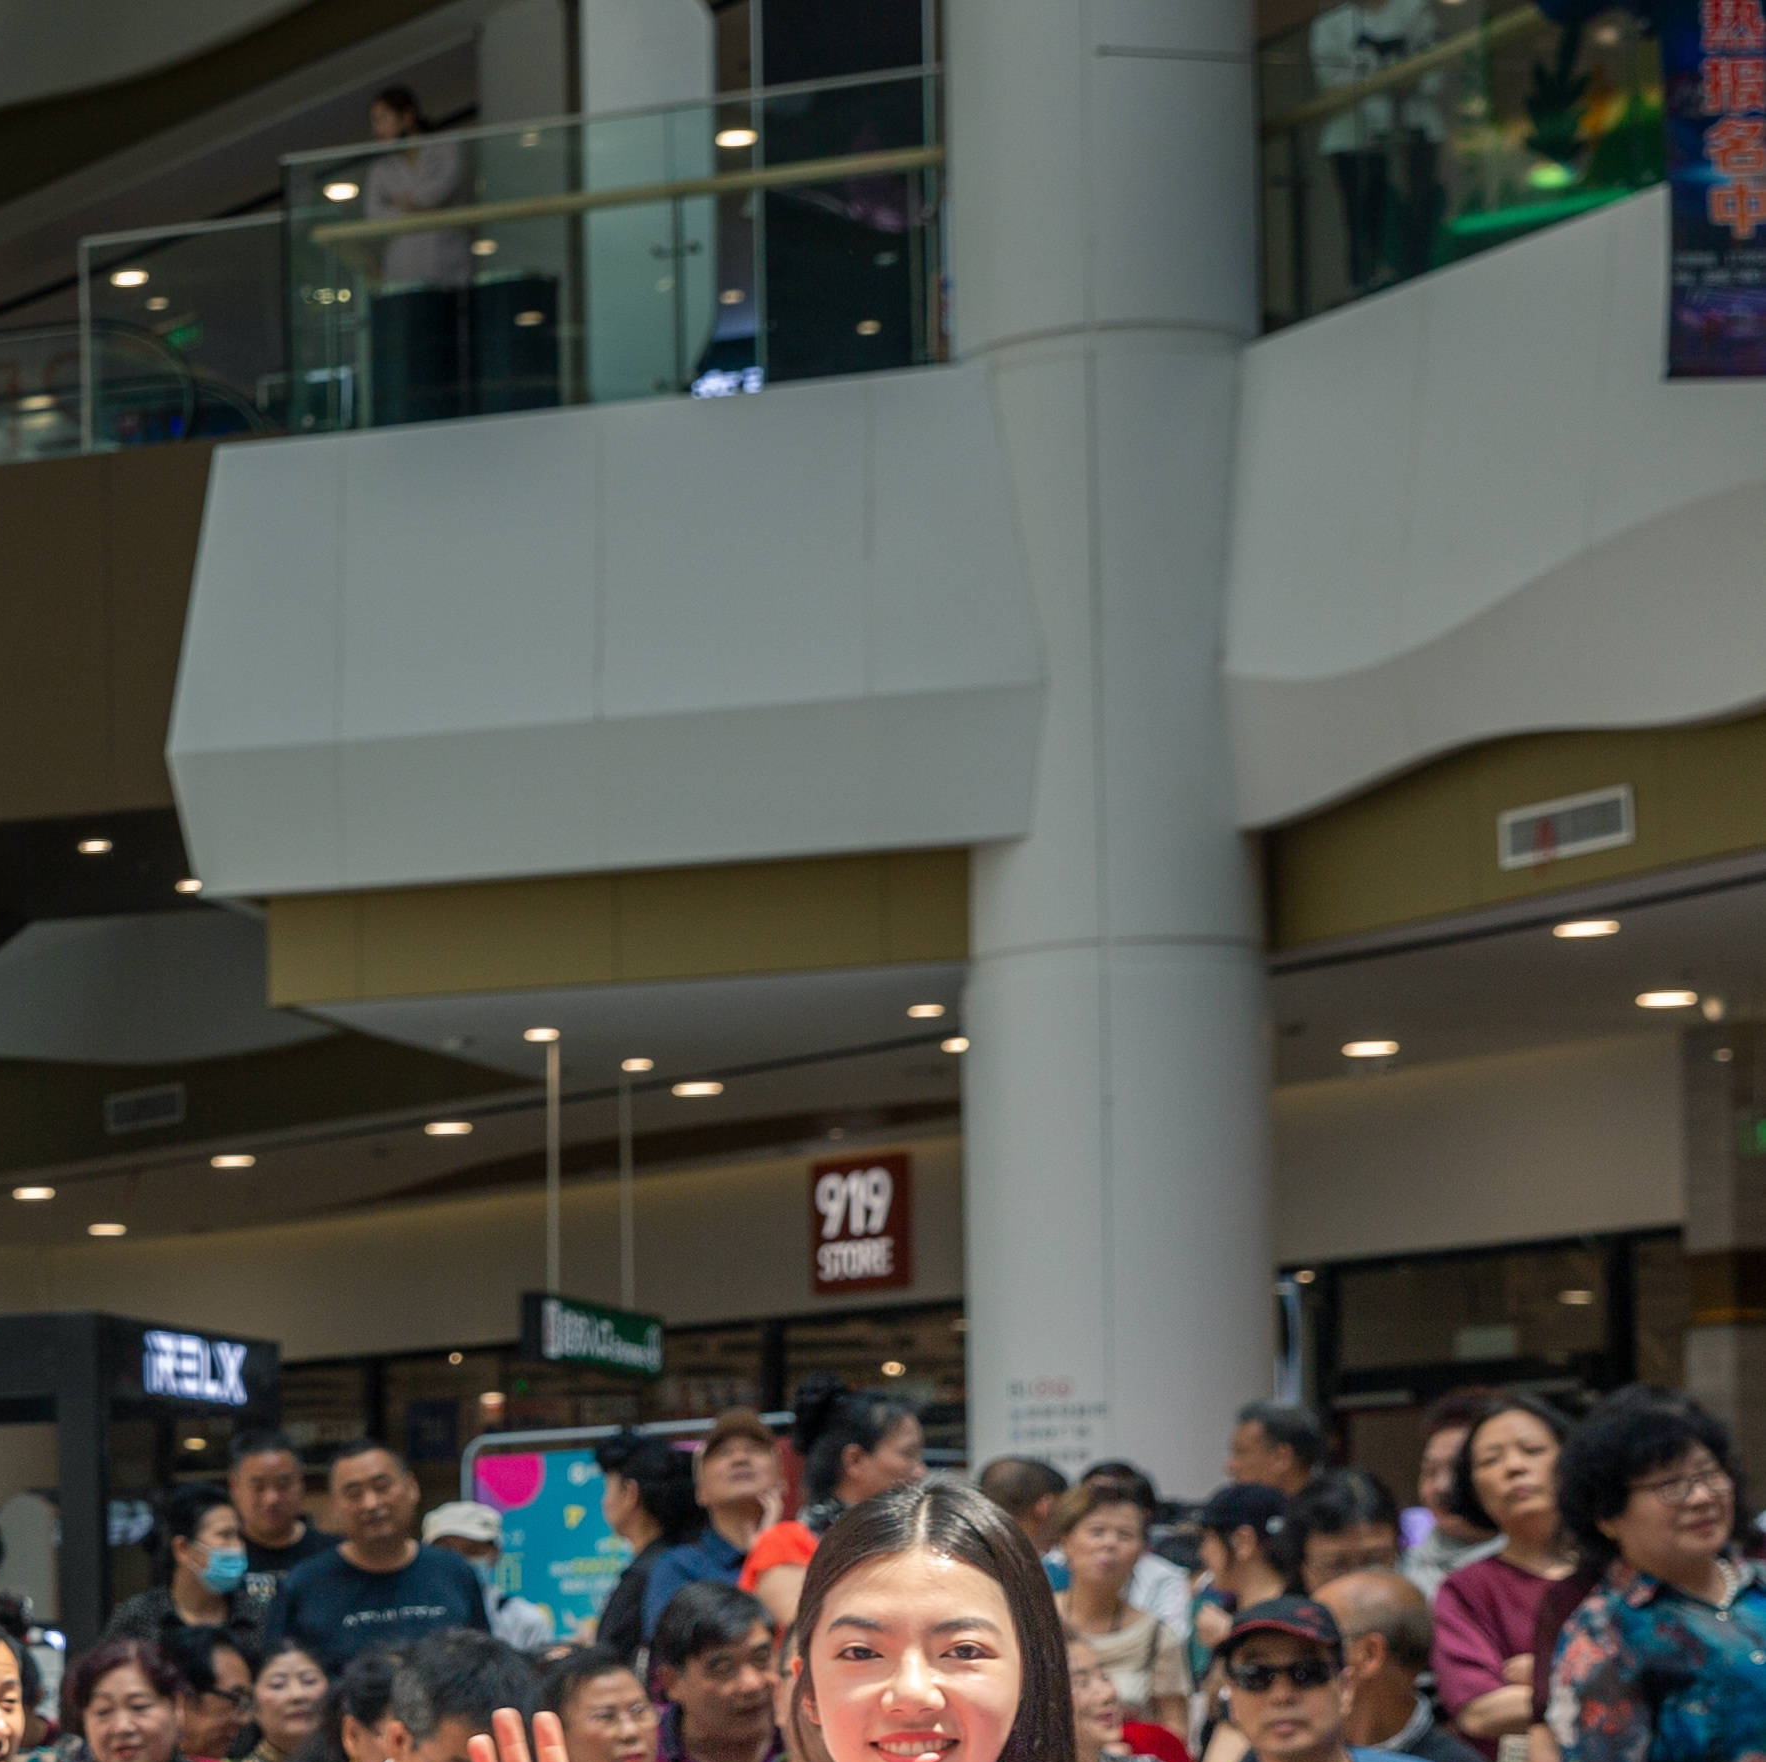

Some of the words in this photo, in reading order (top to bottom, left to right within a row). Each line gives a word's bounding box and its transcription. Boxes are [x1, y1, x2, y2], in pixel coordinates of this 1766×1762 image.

[814, 1166, 895, 1240] 919
[816, 1236, 895, 1282] STORE
[143, 1329, 249, 1406] RELX
